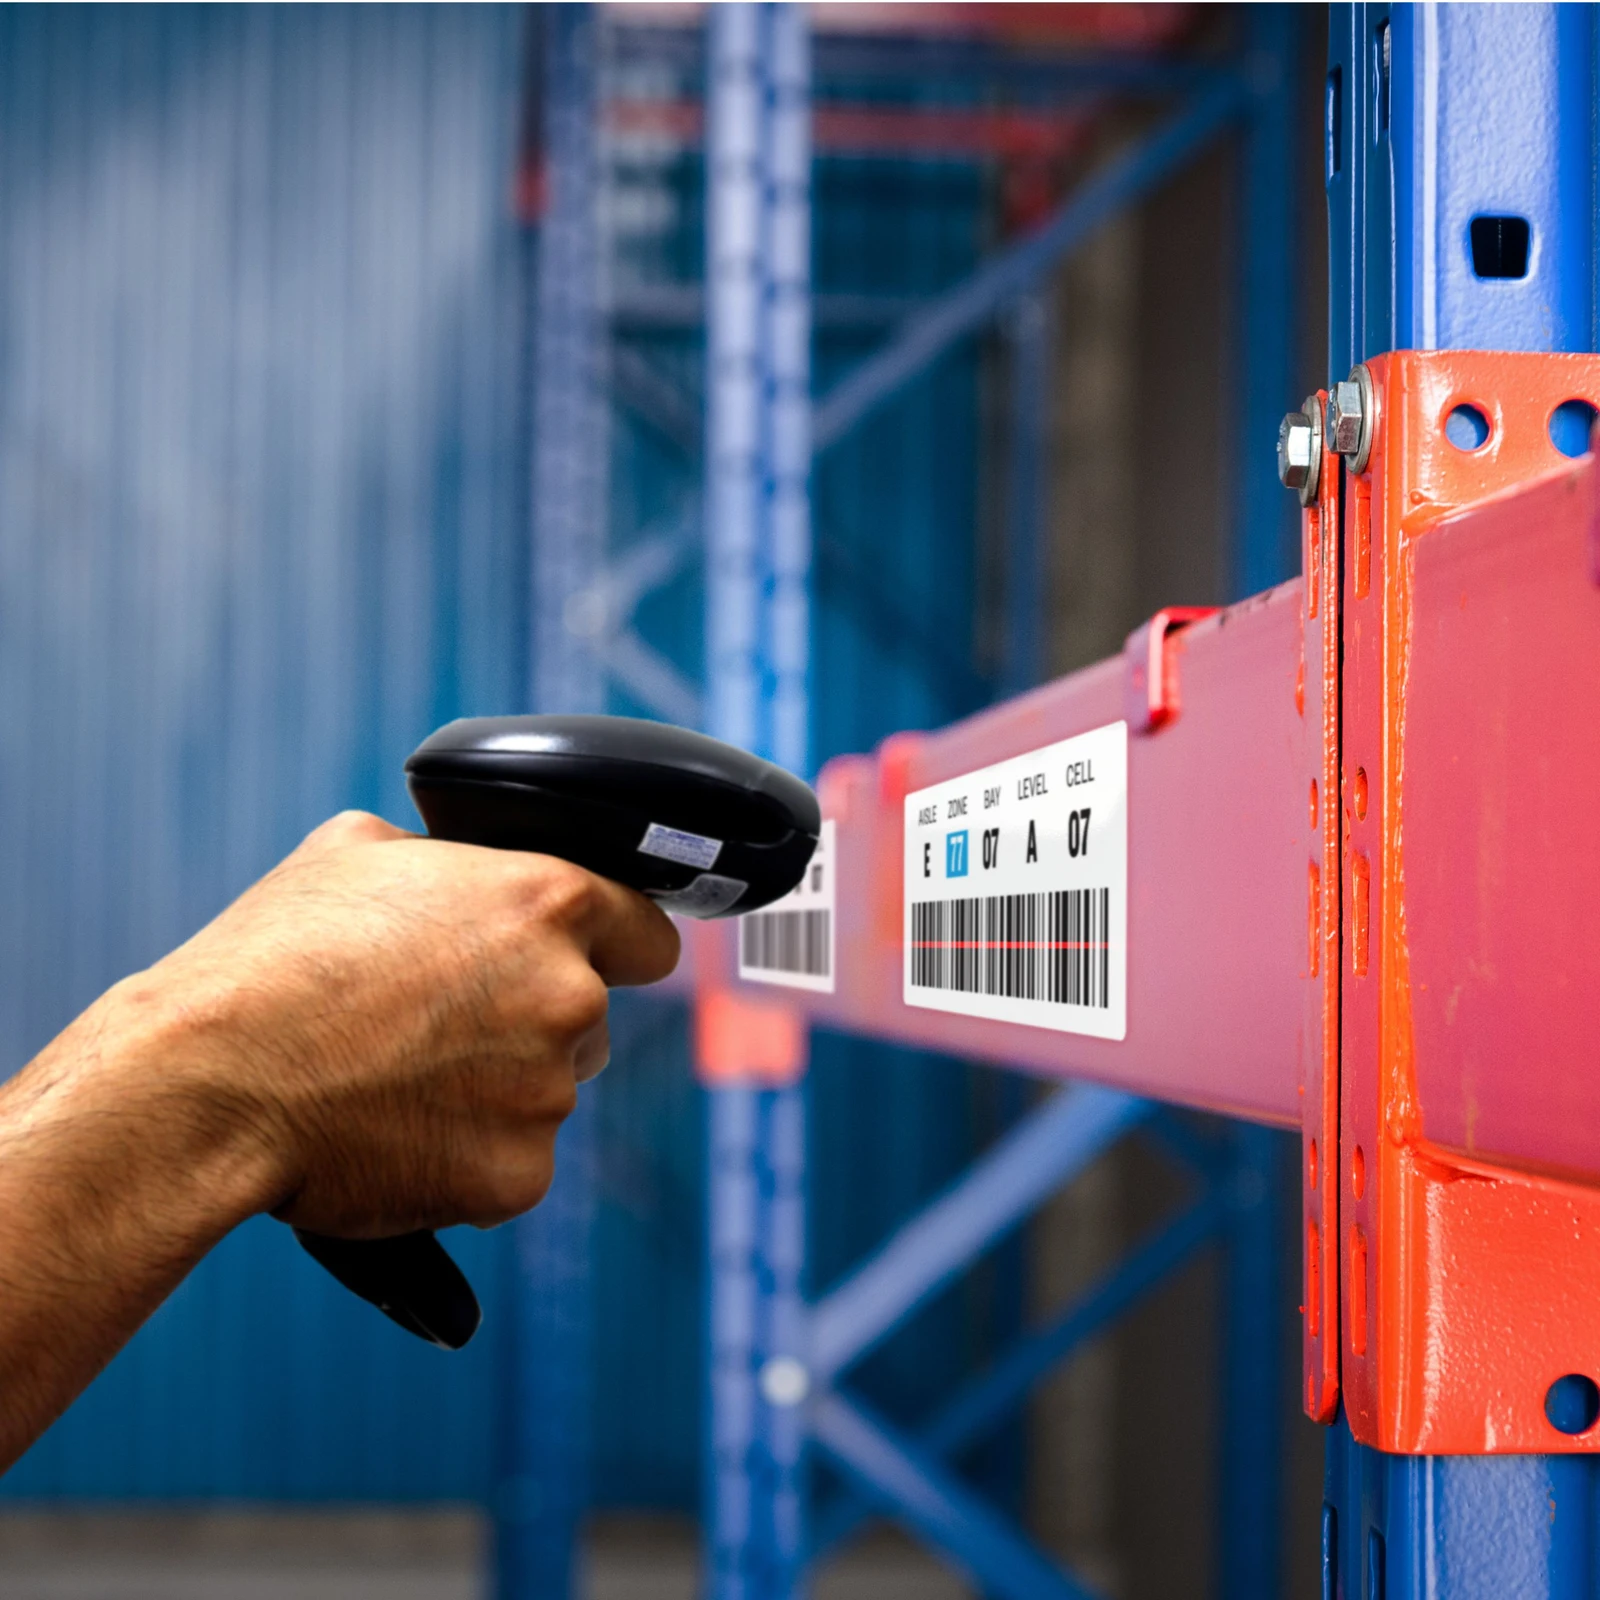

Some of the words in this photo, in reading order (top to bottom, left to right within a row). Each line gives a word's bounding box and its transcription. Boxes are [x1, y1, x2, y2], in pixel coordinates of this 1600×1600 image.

[918, 805, 937, 826] AISLE
[948, 796, 968, 819] ZONE
[983, 786, 1001, 809] BAY
[1017, 773, 1048, 800] LEVEL
[1066, 759, 1095, 787] CELL
[924, 842, 931, 878] E
[950, 835, 964, 873] 77
[982, 828, 1000, 870] 07
[1026, 819, 1038, 864] A
[1068, 808, 1092, 858] 07
